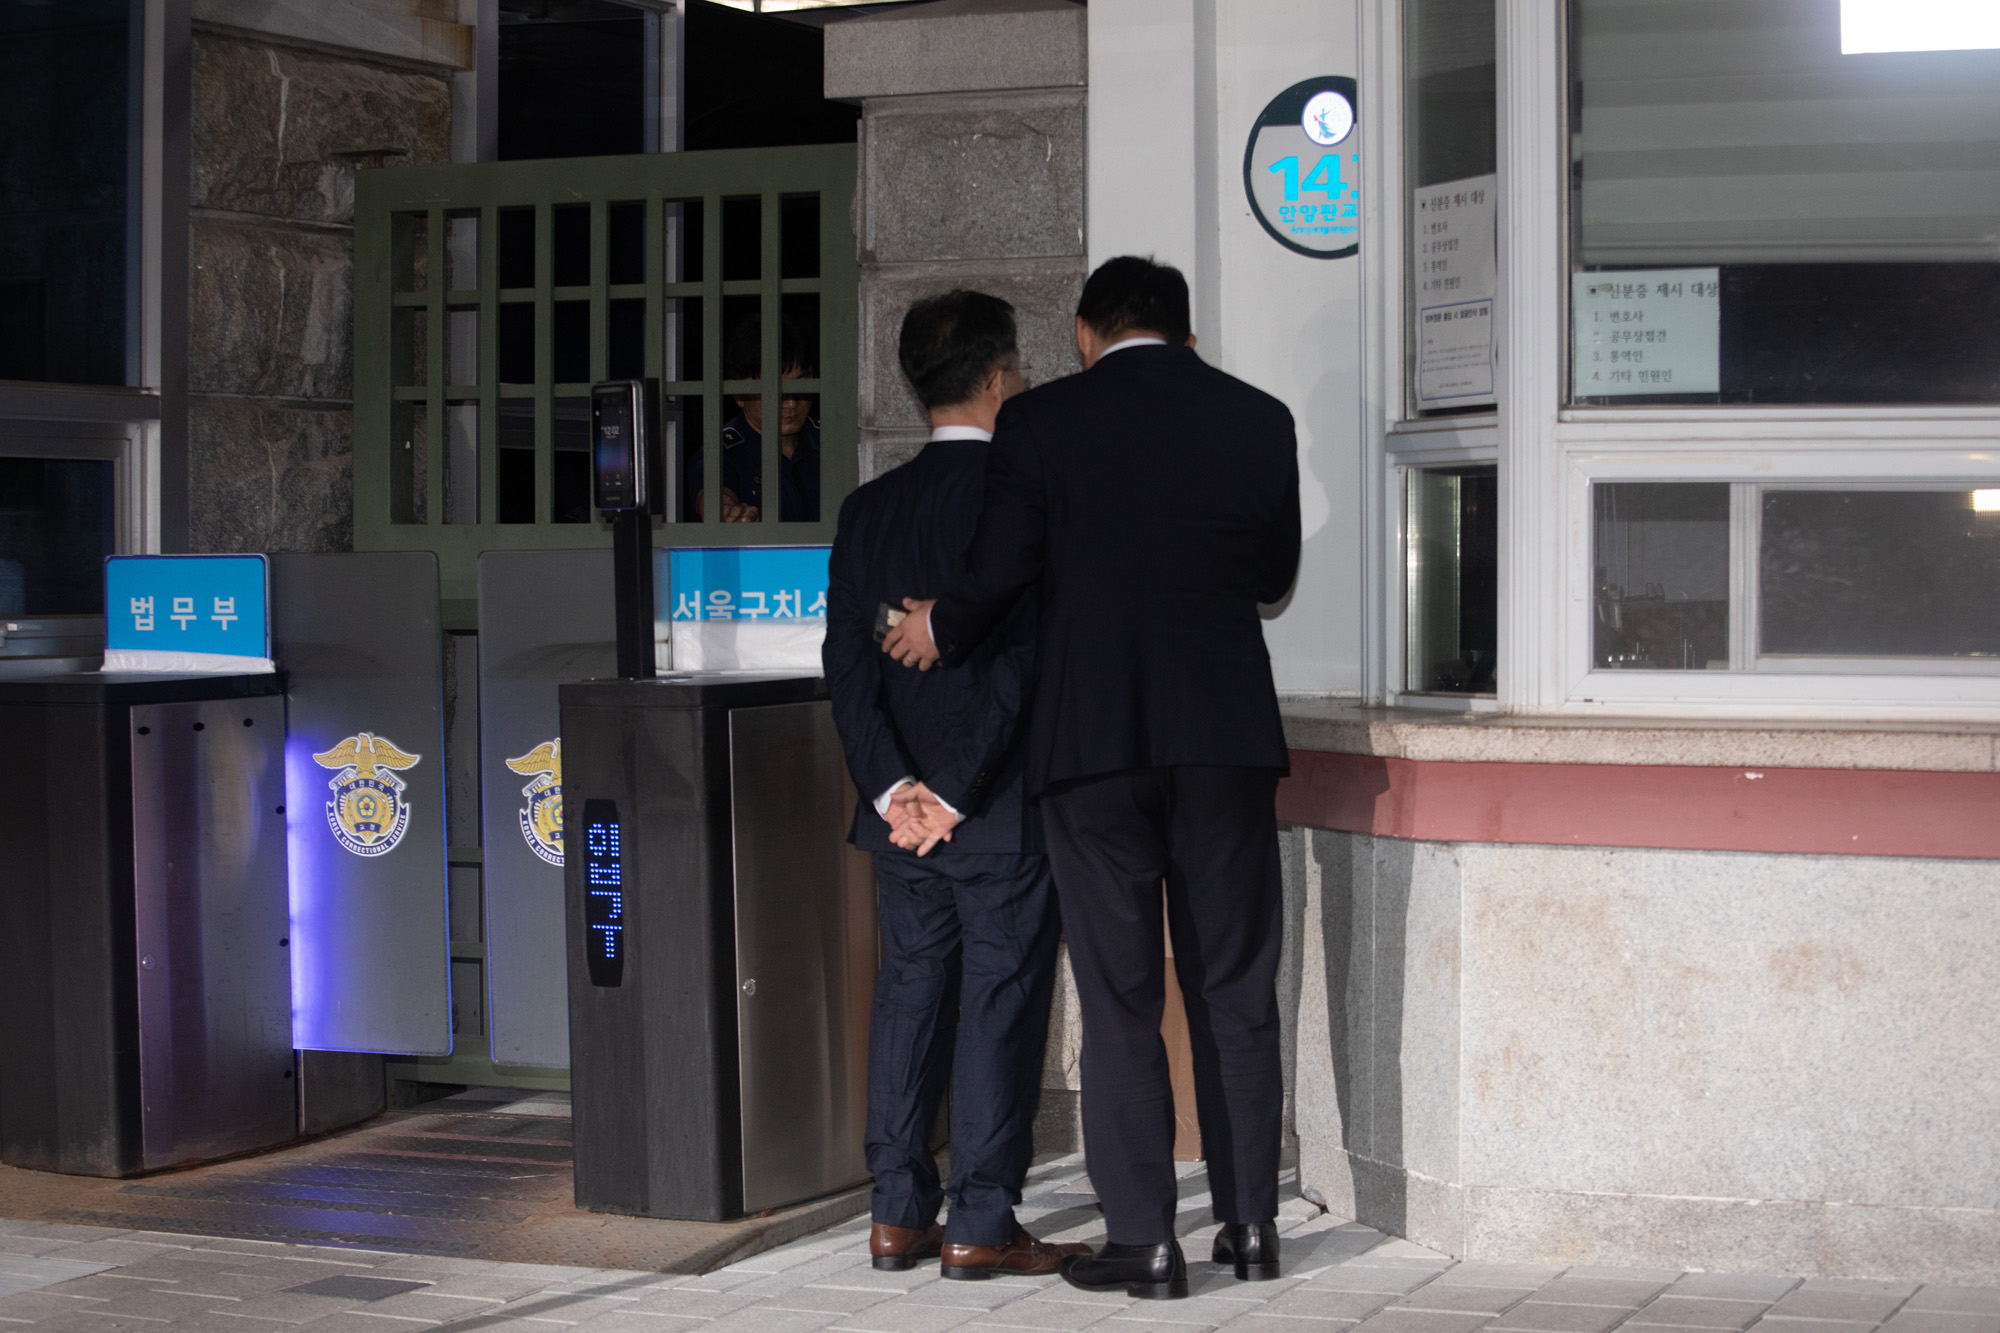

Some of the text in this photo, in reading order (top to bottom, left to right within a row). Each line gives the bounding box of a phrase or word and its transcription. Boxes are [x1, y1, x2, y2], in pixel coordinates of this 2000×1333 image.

[1610, 282, 1719, 299] 신분증 제시 대상
[1609, 311, 1644, 323] 변호사
[1610, 330, 1667, 344] 공무상접견
[1609, 350, 1643, 363] 통역인
[1609, 370, 1632, 382] 기타
[1638, 369, 1672, 383] 민원인
[329, 812, 406, 854] KOREA CORRECTIONAL SERVICE
[522, 820, 535, 845] KOREA
